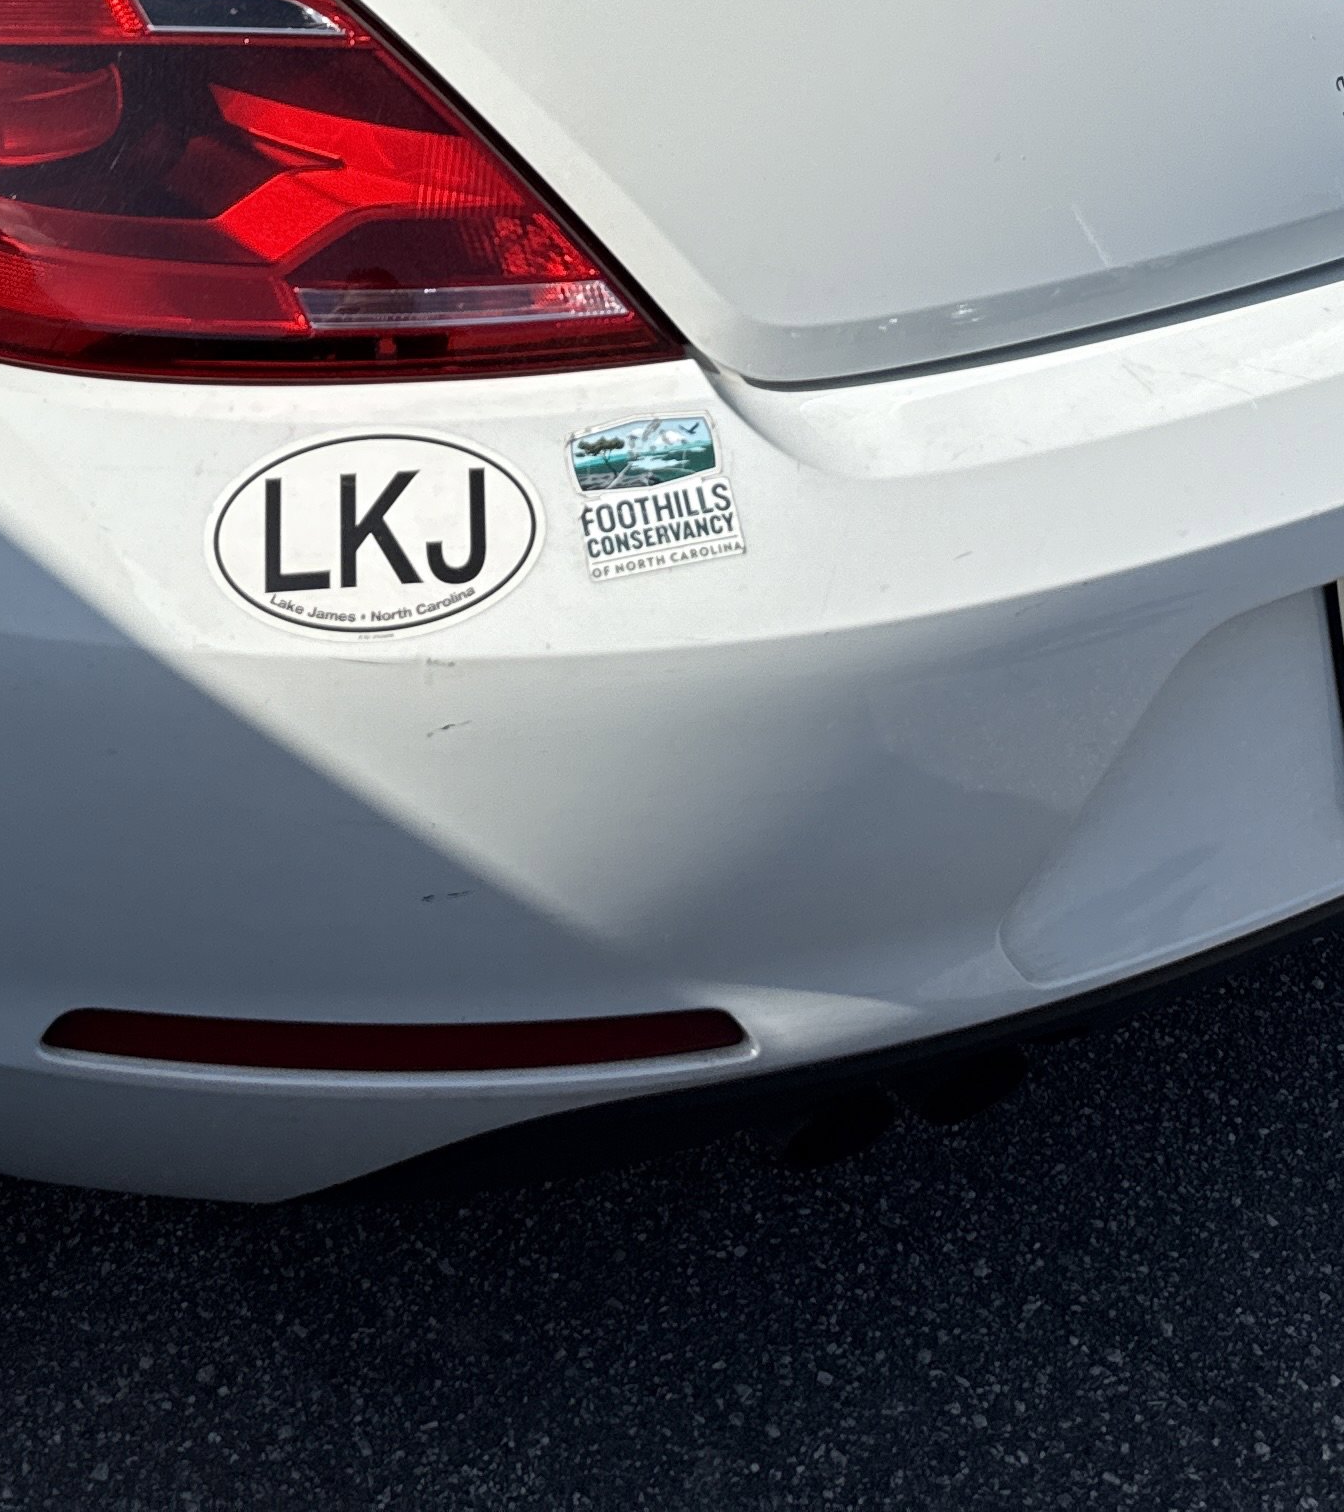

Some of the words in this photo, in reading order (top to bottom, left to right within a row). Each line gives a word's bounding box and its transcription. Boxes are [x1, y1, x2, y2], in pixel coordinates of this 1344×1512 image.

[264, 466, 487, 594] LKJ
[580, 482, 732, 537] FOOTHILLS
[587, 511, 734, 559] CONSERVANCY
[591, 567, 611, 579] OF
[615, 555, 666, 573] NORTH
[669, 541, 743, 563] CAROLINA
[269, 593, 305, 616] Lake
[307, 606, 357, 623] James
[370, 607, 413, 623] North
[415, 585, 477, 616] Carolina
